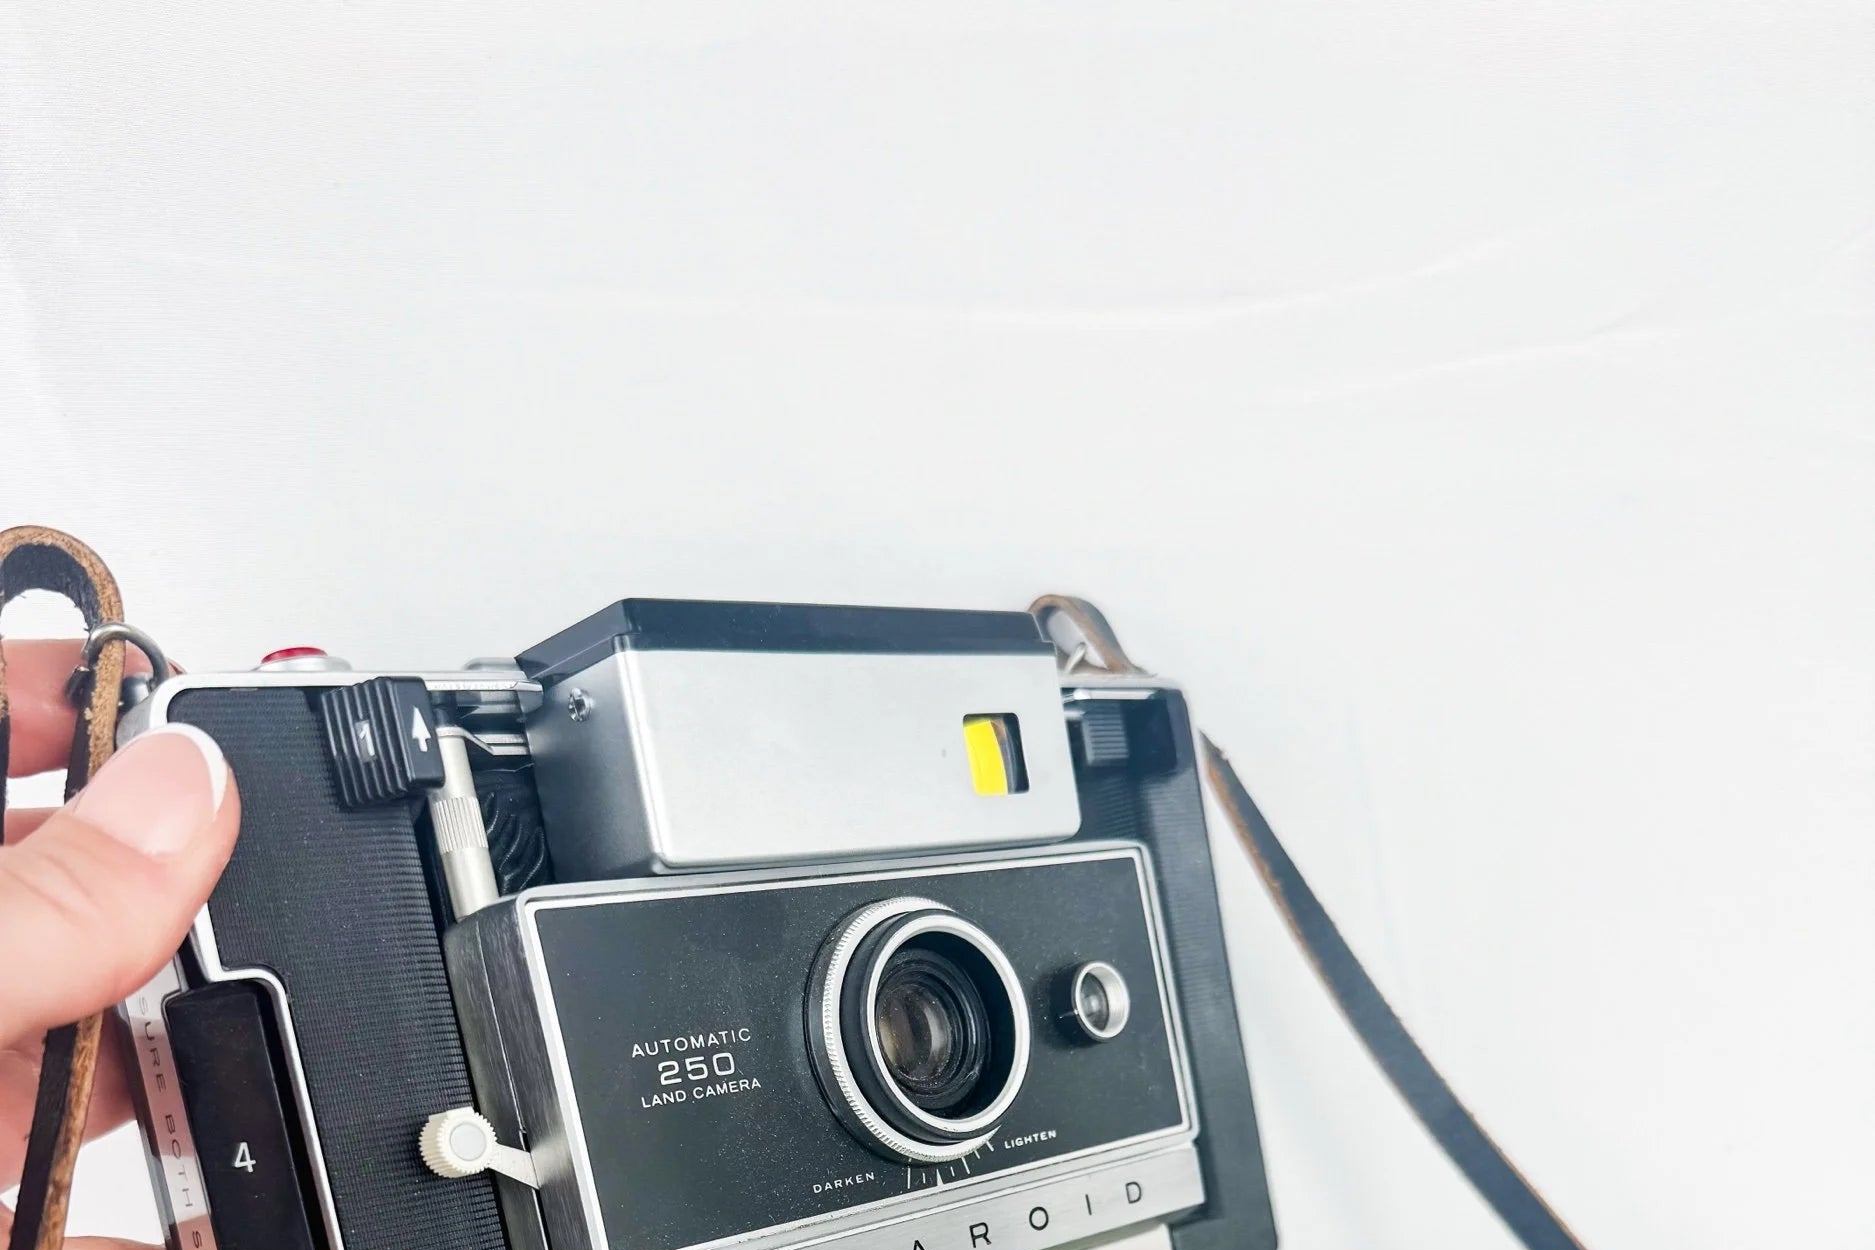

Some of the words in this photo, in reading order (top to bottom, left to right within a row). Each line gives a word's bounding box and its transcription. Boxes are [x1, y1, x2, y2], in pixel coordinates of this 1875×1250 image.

[359, 721, 376, 757] 1
[631, 1027, 751, 1058] AUTOMATIC
[657, 1052, 735, 1086] 250
[138, 997, 167, 1093] SURE
[164, 1113, 193, 1207] BOTH
[641, 1090, 687, 1108] LAND
[693, 1077, 762, 1099] CAMERA
[1004, 1129, 1057, 1150] LIGHTEN
[234, 1141, 256, 1173] 4
[812, 1171, 876, 1194] DARKEN
